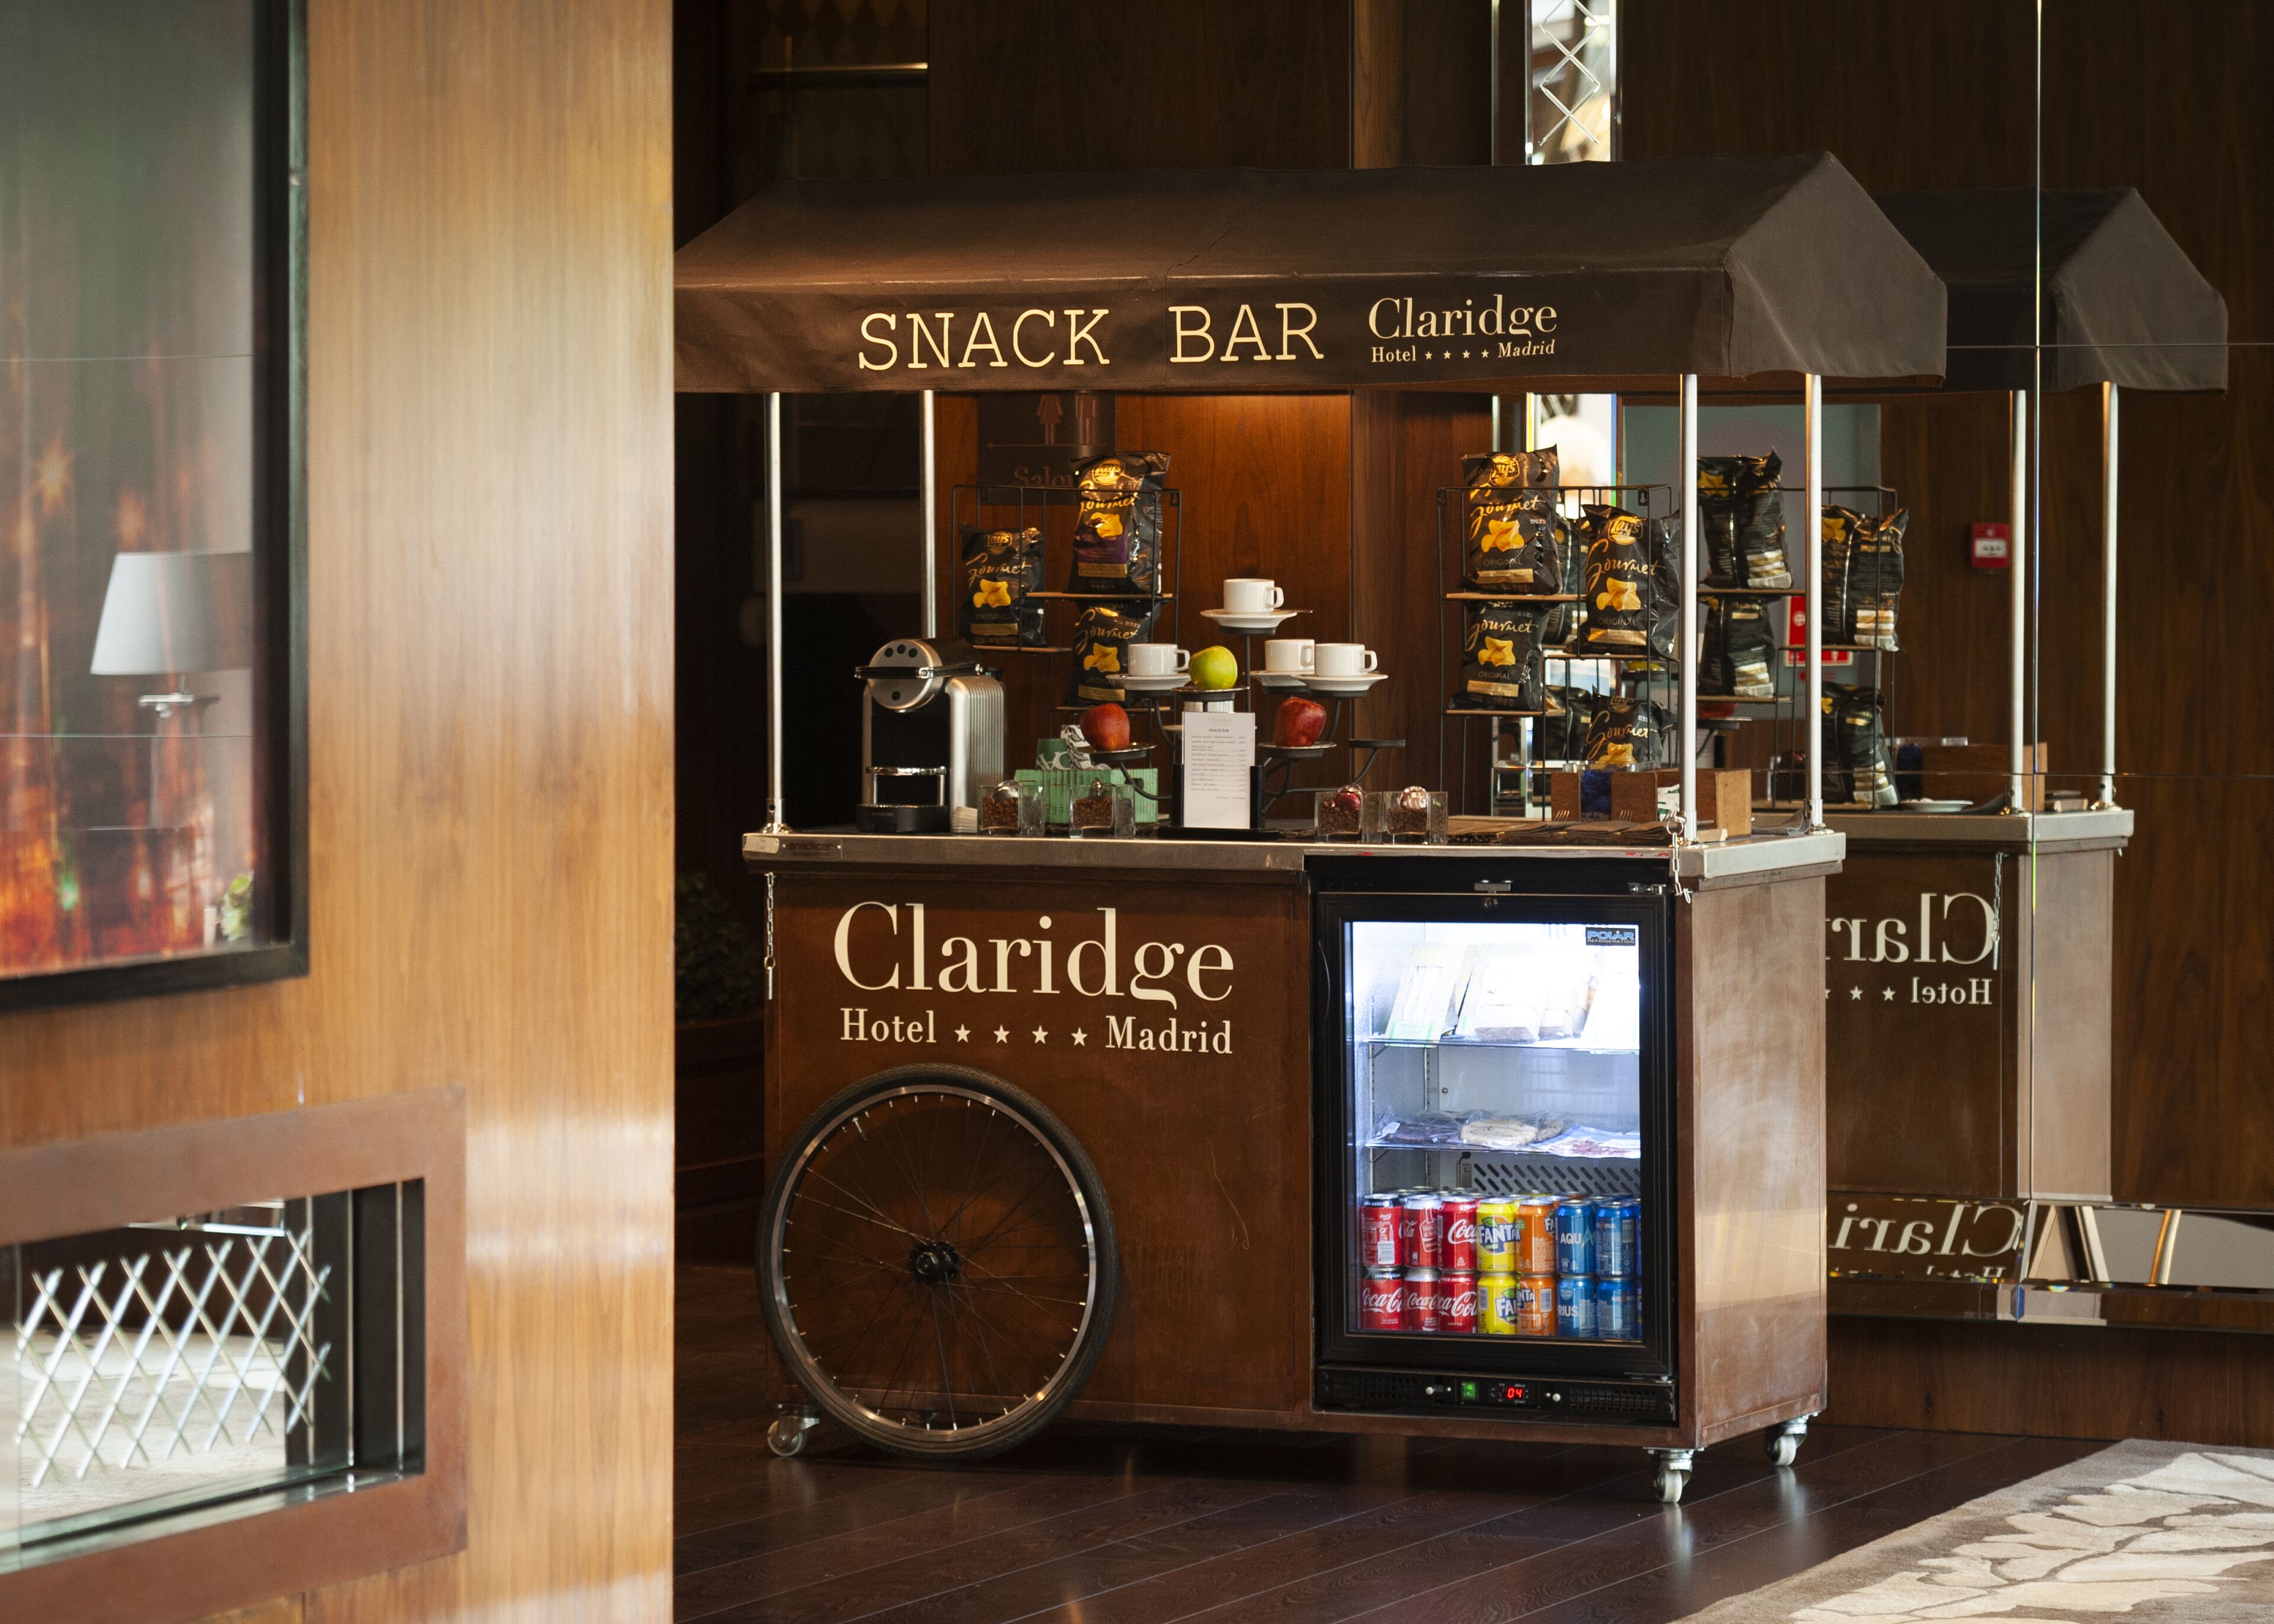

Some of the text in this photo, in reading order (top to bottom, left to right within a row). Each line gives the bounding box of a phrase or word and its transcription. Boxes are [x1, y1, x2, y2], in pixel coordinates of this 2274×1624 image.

[1368, 294, 1557, 339] Claridge
[859, 302, 1325, 372] SNACK BAR
[1371, 339, 1556, 363] Hotel Madrid
[1587, 930, 1634, 940] POLAR
[834, 901, 1234, 1010] Claridge
[840, 1008, 1233, 1054] Hotel Madrid
[1478, 1223, 1521, 1244] FANTA
[1506, 1386, 1524, 1400] 04
